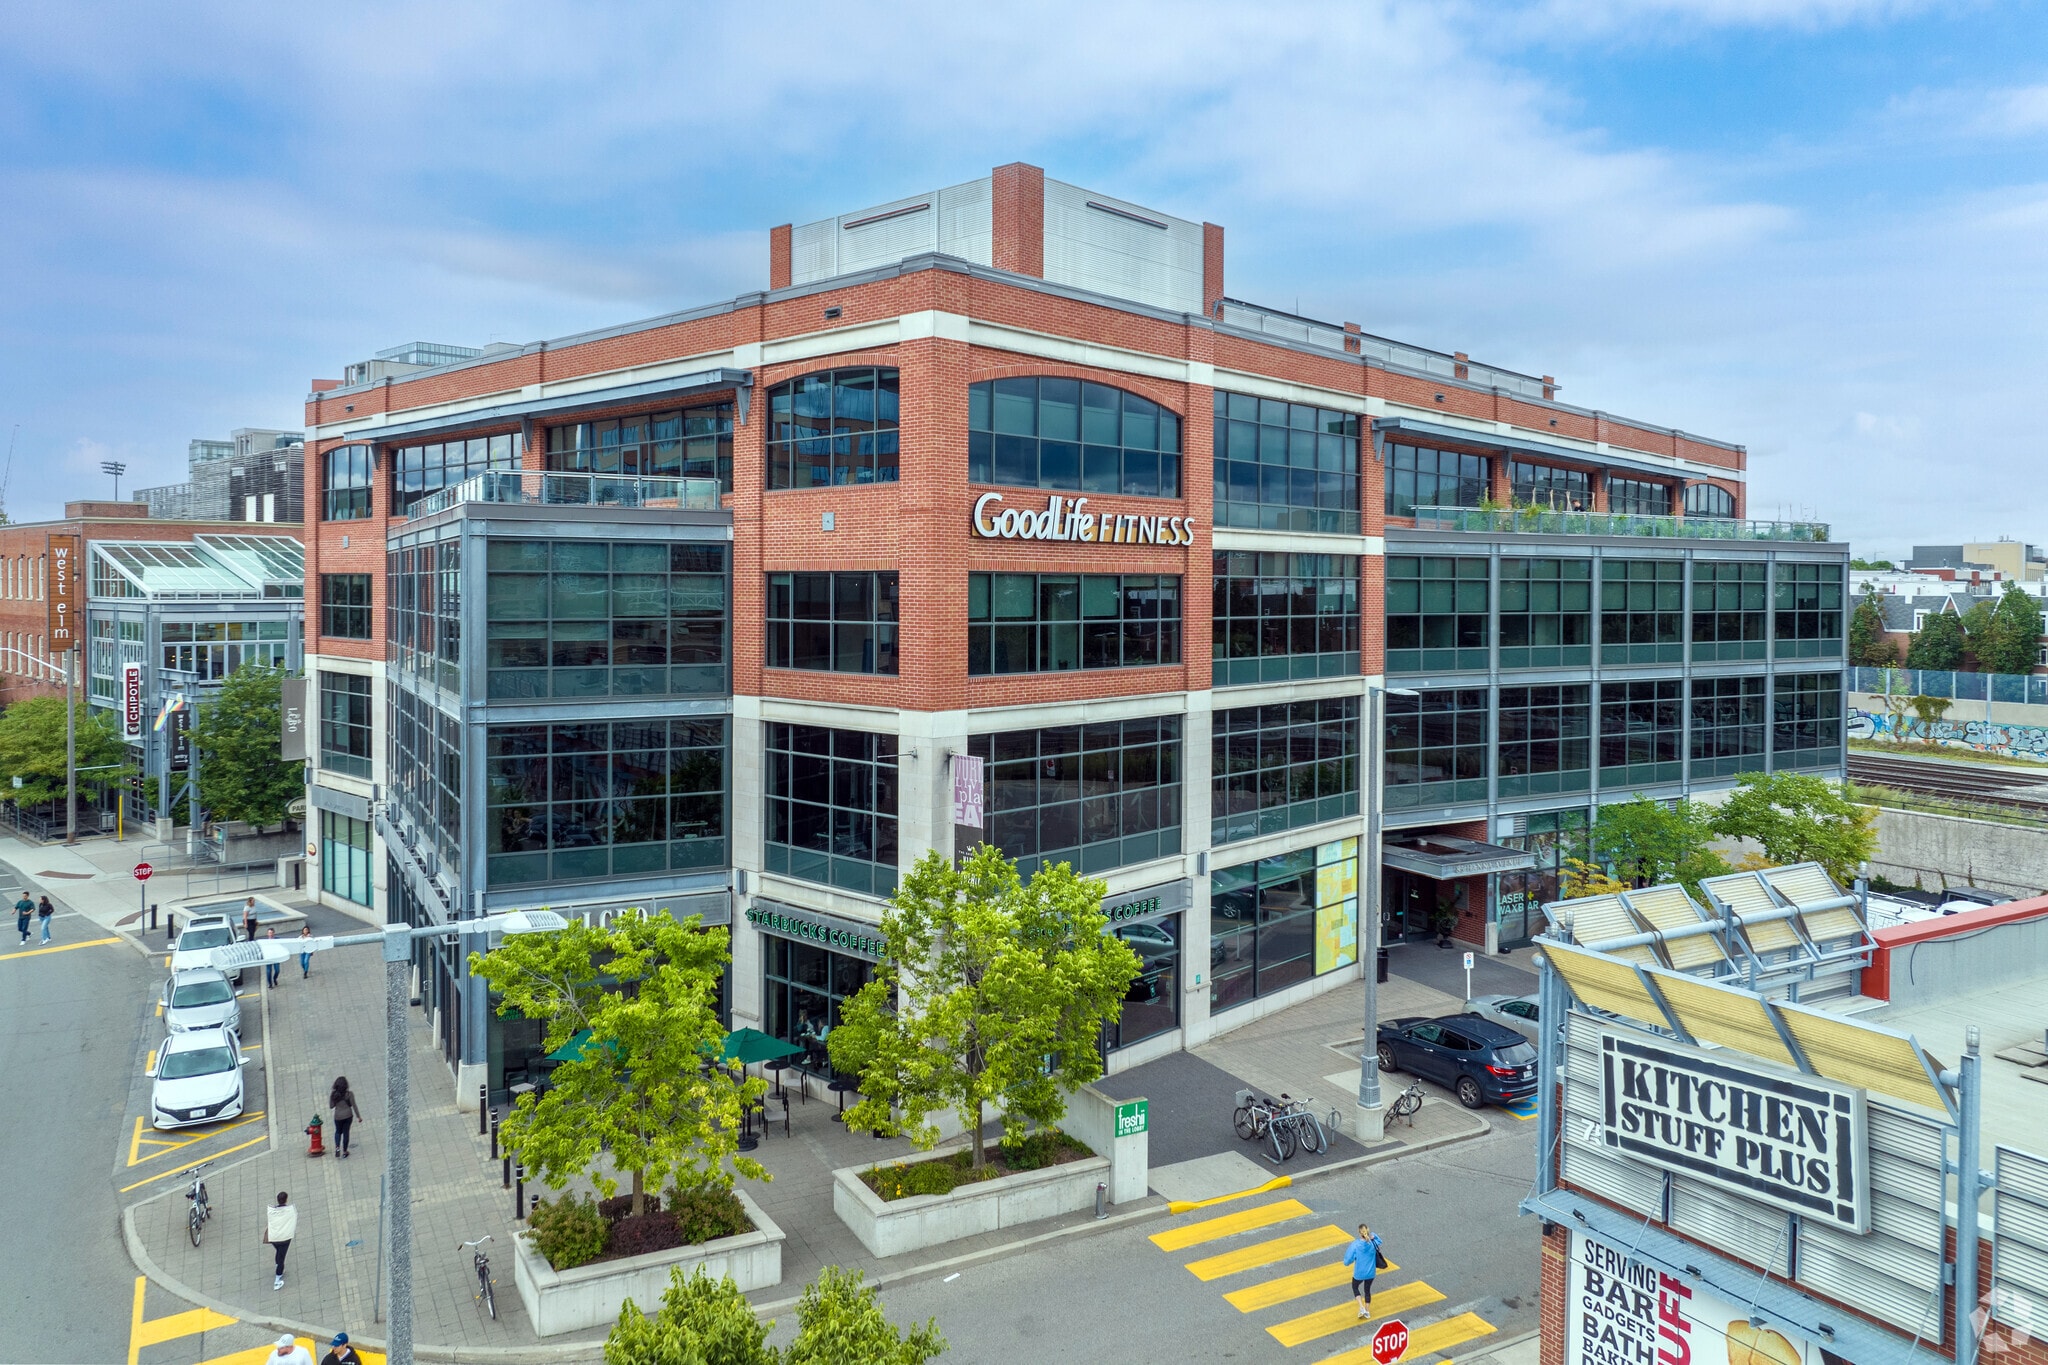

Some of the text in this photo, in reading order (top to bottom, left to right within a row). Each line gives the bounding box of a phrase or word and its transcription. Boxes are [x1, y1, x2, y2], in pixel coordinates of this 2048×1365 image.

[974, 492, 1195, 546] GoodLife FITNESS
[54, 547, 69, 639] west elm
[129, 670, 138, 721] CHIPOTLE
[292, 804, 306, 812] PAR
[959, 784, 983, 808] pla
[134, 867, 152, 876] STOP
[746, 908, 887, 957] STARBUCKS COFFEE
[1114, 896, 1162, 921] COFFEE
[1118, 1103, 1145, 1130] freshii
[1621, 1058, 1828, 1154] KITCHEN
[1621, 1101, 1830, 1194] STUFF PLUS
[1585, 1239, 1656, 1293] SERVING
[1582, 1296, 1655, 1342] GADGETS
[1583, 1265, 1655, 1325] BAR
[1375, 1331, 1407, 1354] STOP
[1582, 1336, 1633, 1365] BAKI
[1583, 1311, 1654, 1365] BATH
